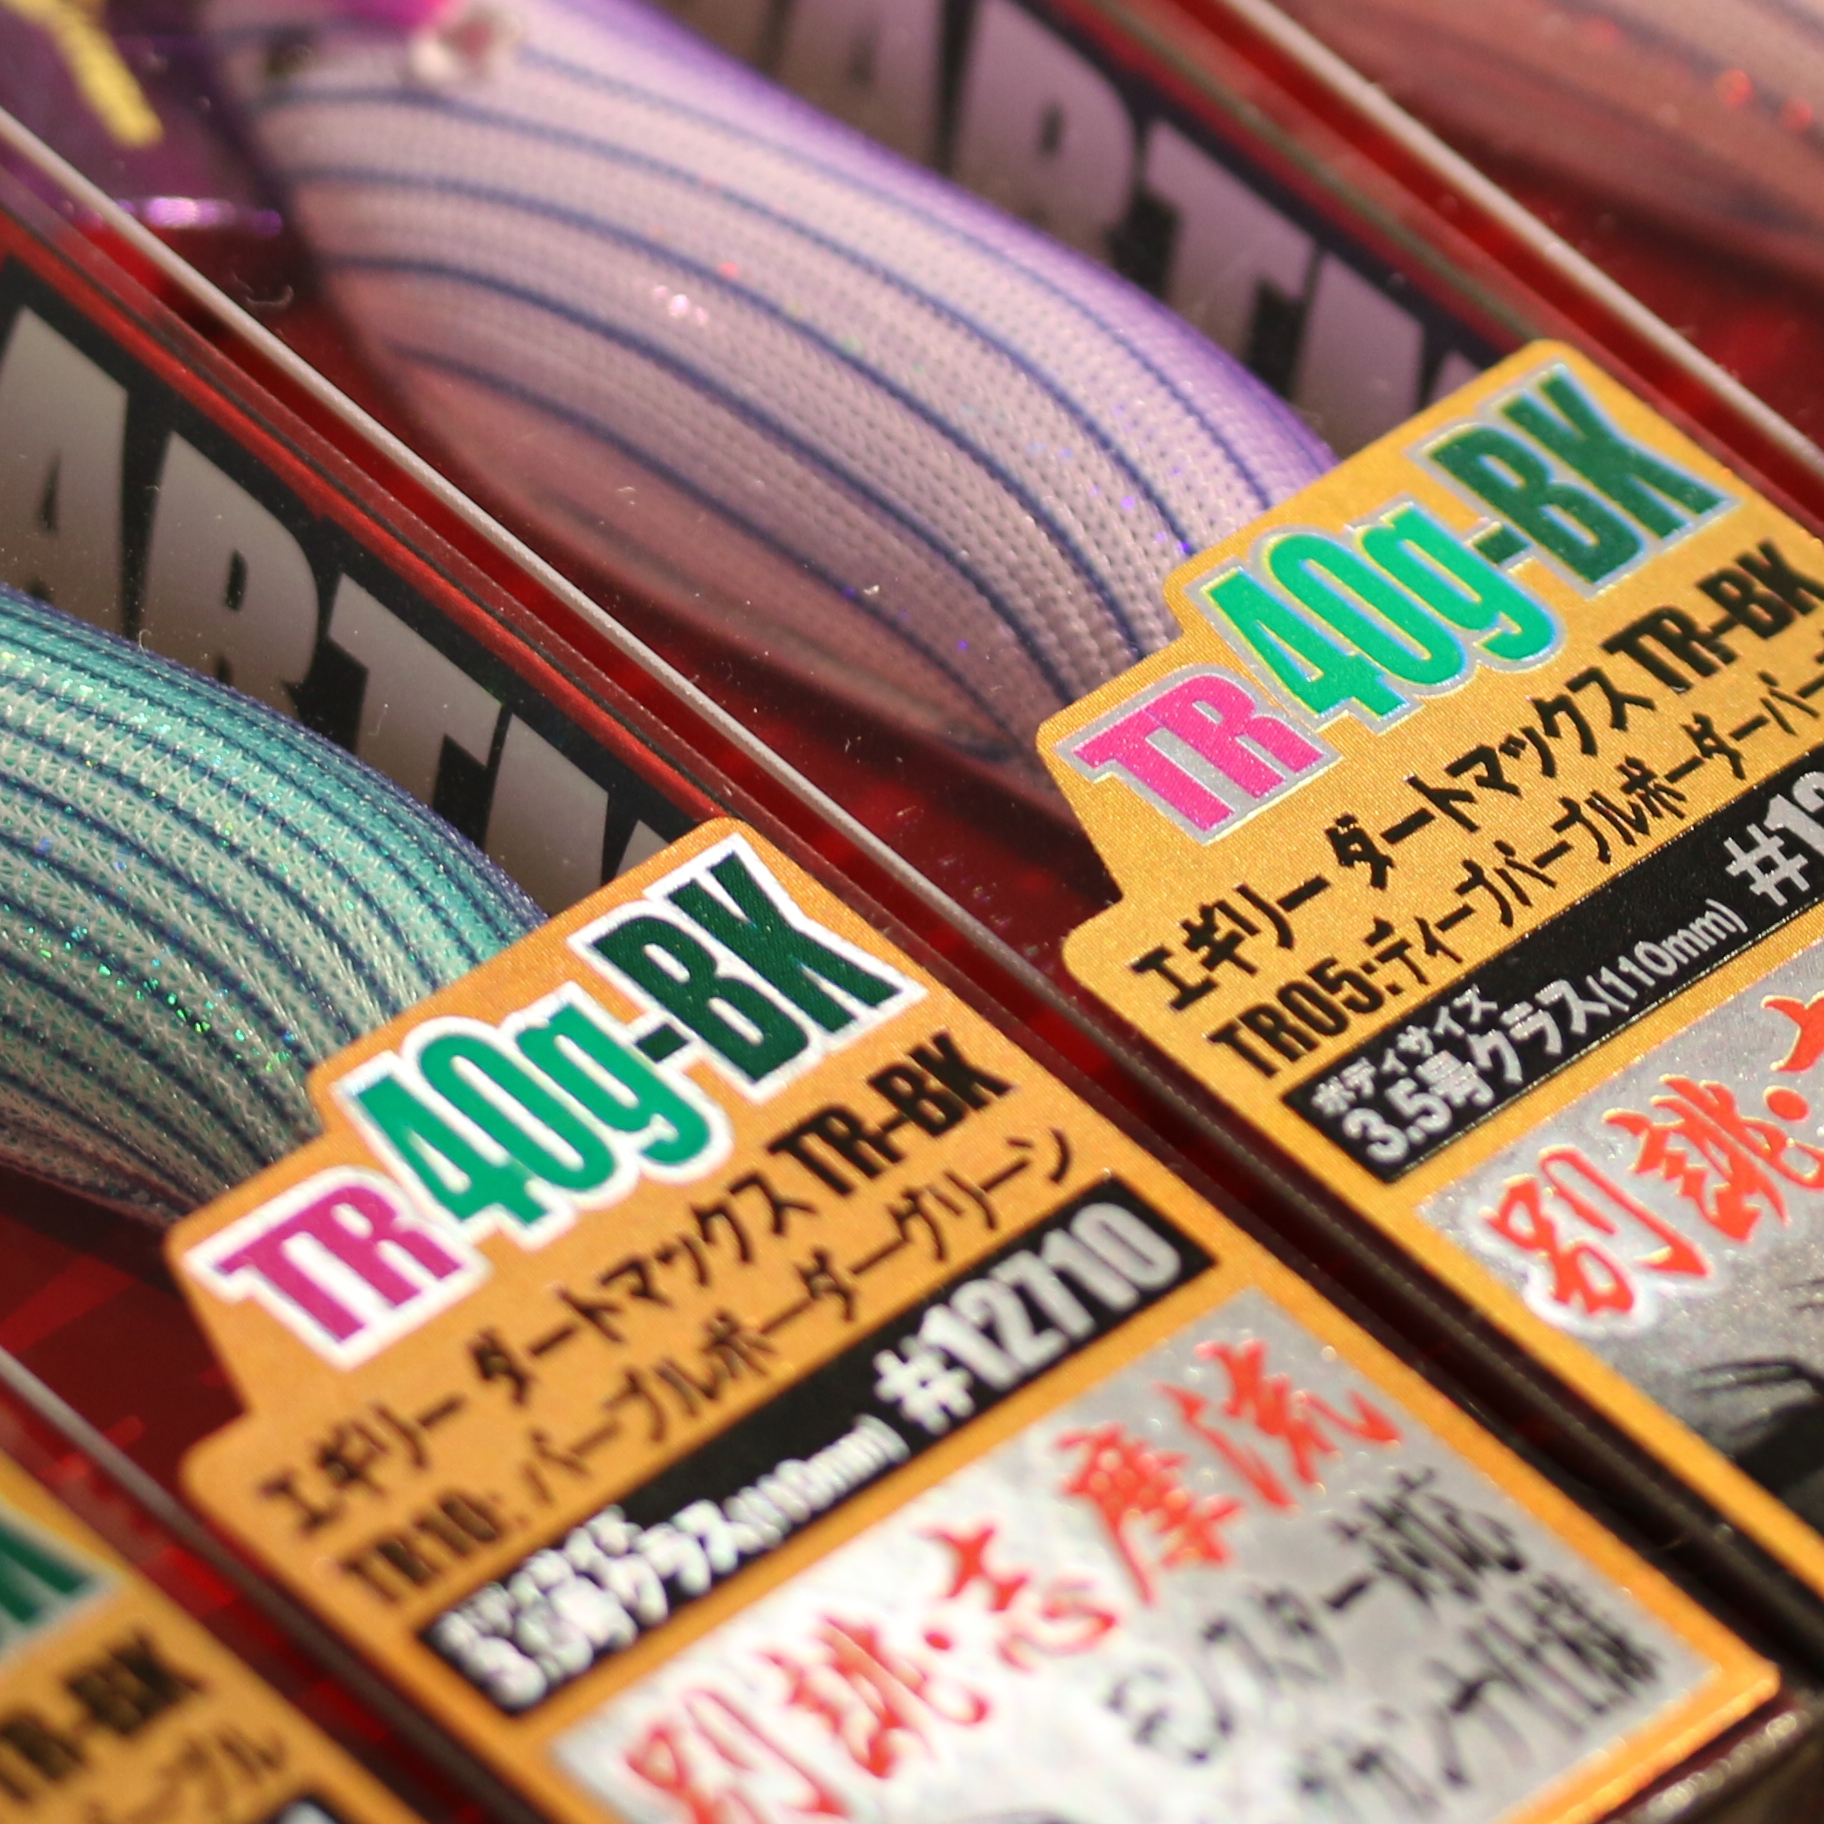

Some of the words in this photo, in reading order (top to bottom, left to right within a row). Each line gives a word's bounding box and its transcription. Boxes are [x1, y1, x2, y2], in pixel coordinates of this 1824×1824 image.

[1129, 874, 1330, 1011] エギリー
[1328, 666, 1653, 891] ダートマックス
[1311, 986, 1498, 1116] ボディサイズ
[257, 1395, 464, 1535] エギリー
[469, 1170, 813, 1408] ダートマックス
[767, 1032, 1012, 1198] TR-BK
[876, 1202, 1177, 1433] #12710
